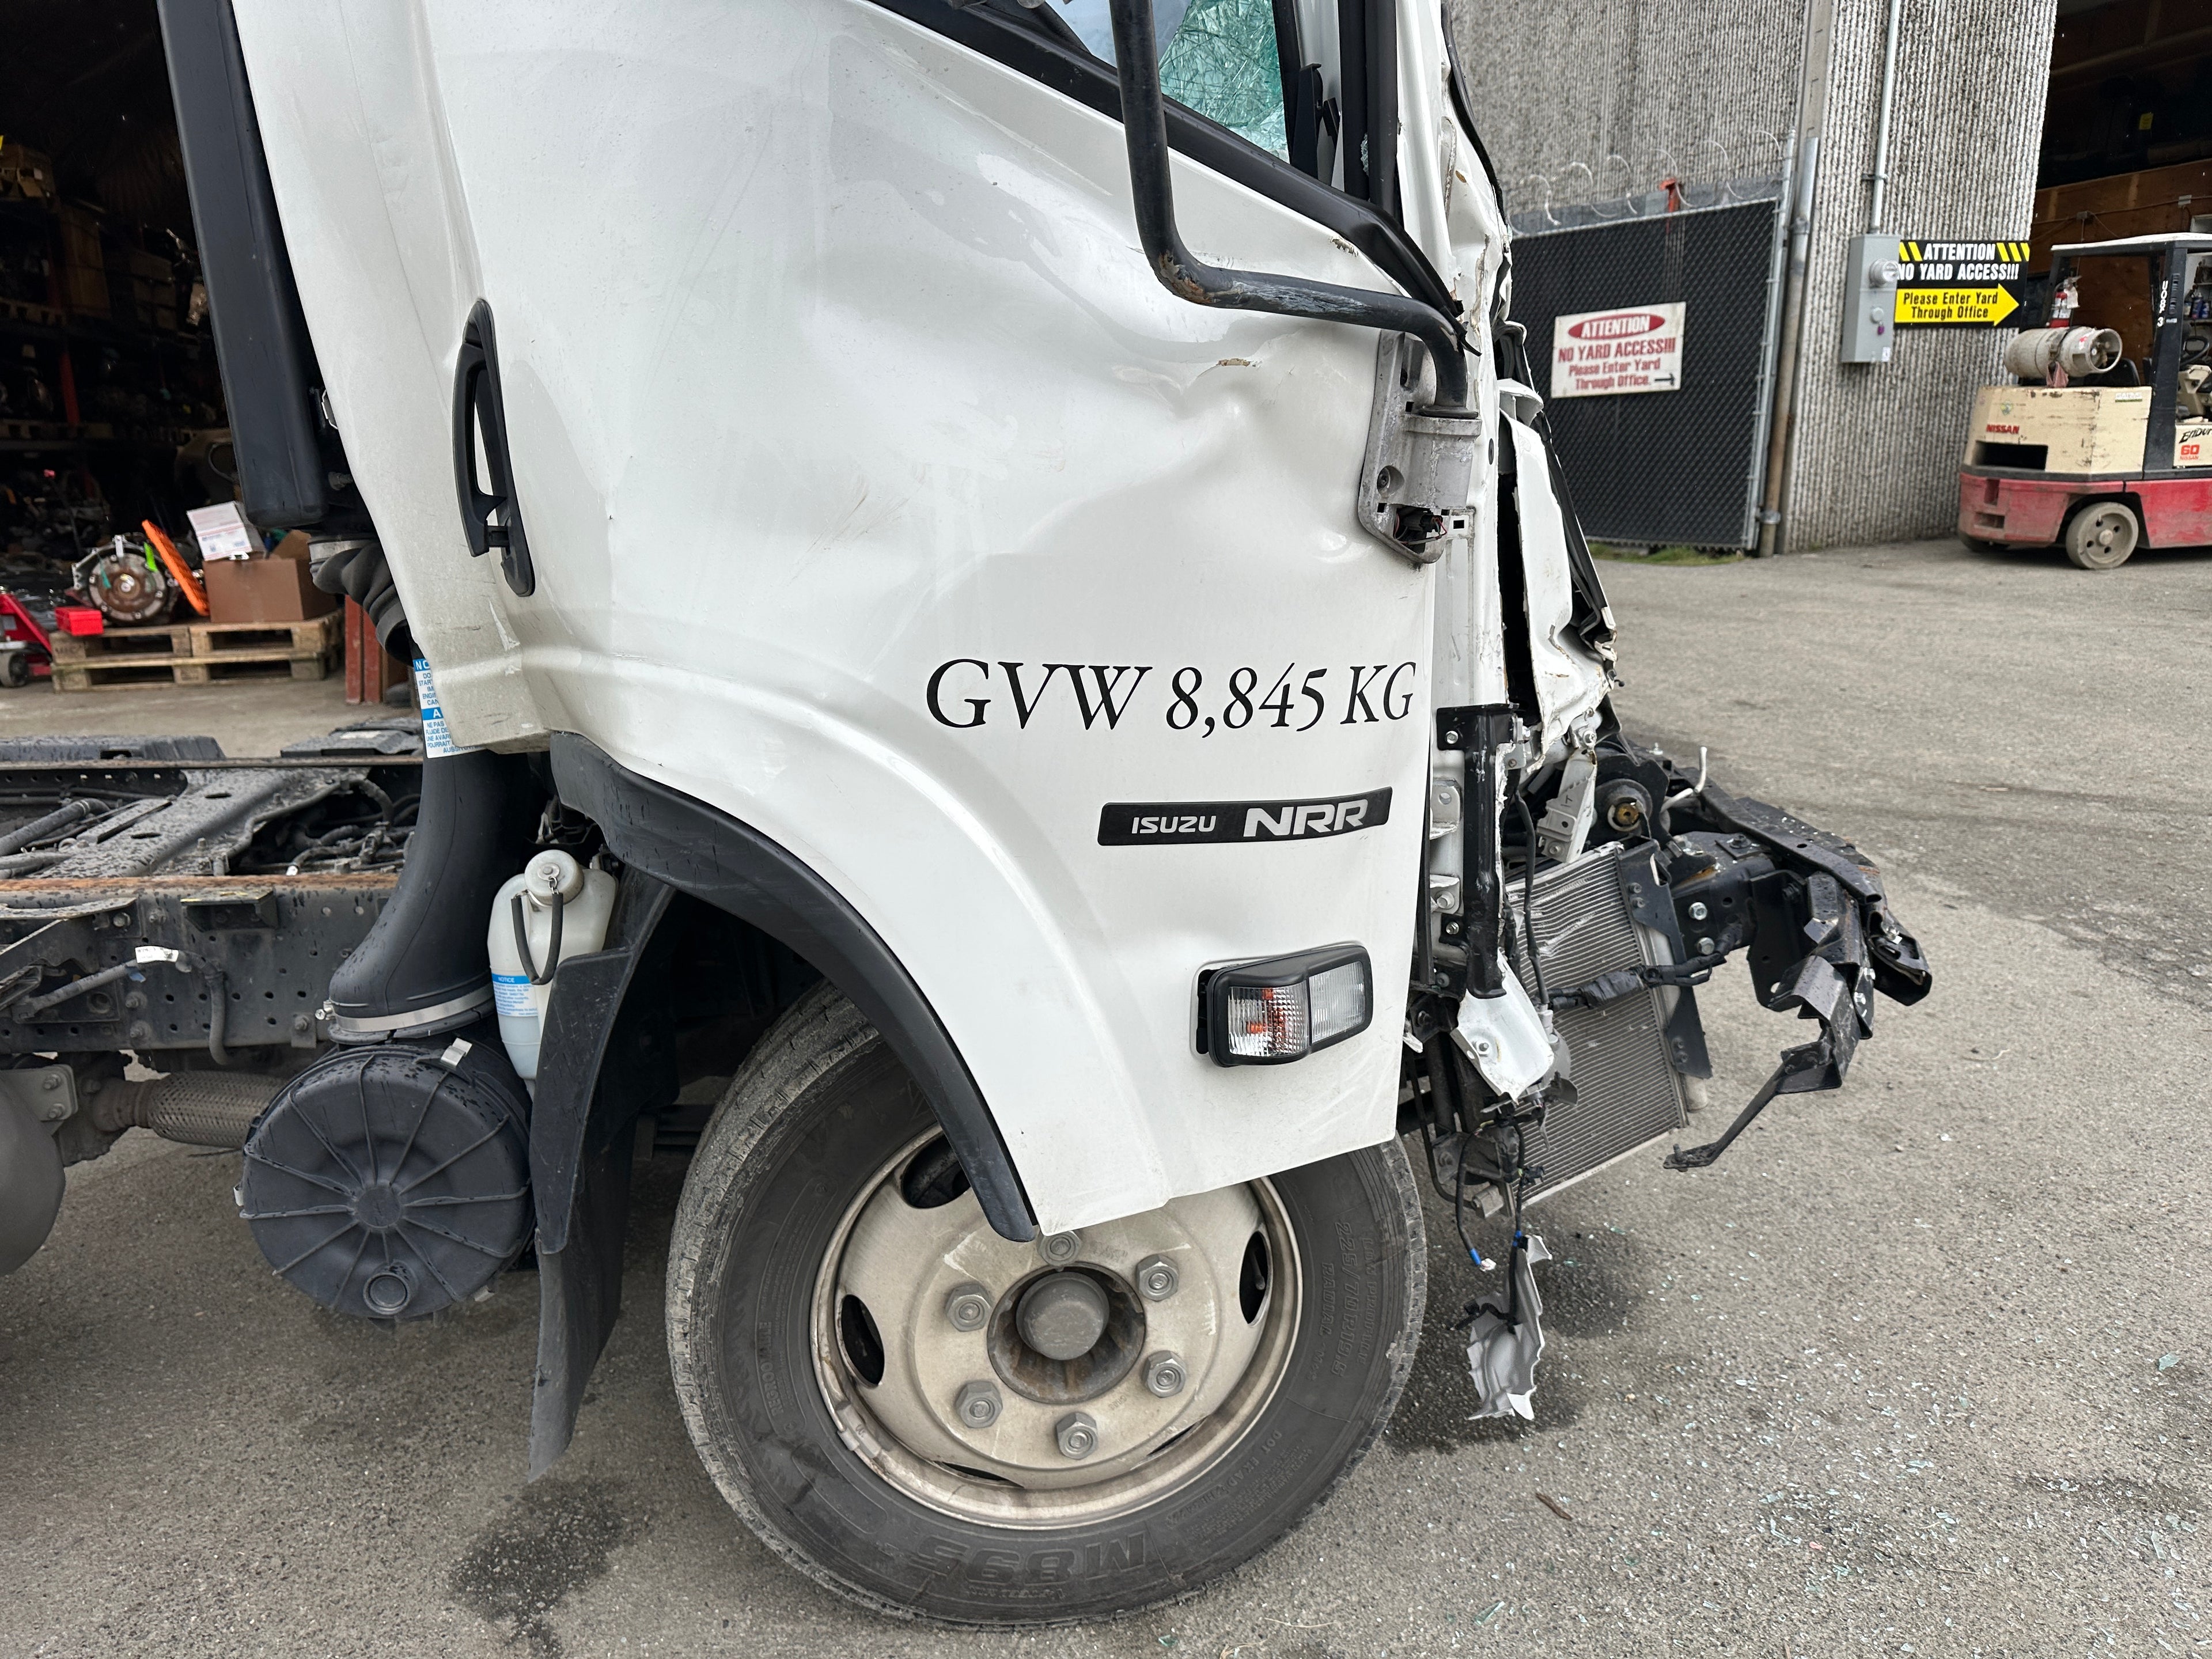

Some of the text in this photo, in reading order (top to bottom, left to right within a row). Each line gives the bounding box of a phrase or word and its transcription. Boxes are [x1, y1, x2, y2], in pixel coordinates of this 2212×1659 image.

[1923, 243, 1997, 260] ATTENTION
[1897, 263, 2020, 281] NO YARD ACCESS!!!
[1903, 291, 1999, 305] Please Enter Yard
[1912, 305, 1989, 321] Through Office
[1581, 316, 1651, 338] ATTENTION
[1558, 347, 1574, 363] NO
[1578, 344, 1611, 360] YARD
[1569, 358, 1661, 377] Please Enter Yard
[1575, 377, 1615, 391] Through
[1986, 423, 2020, 435] NISSAN
[2181, 444, 2200, 455] 60
[926, 658, 1417, 738] GVW 8,845 KG
[1130, 798, 1369, 838] ISUZU NRR
[1319, 1262, 1336, 1337] RADIAL
[1261, 1430, 1282, 1453] DOT
[907, 1531, 1146, 1586] M895
